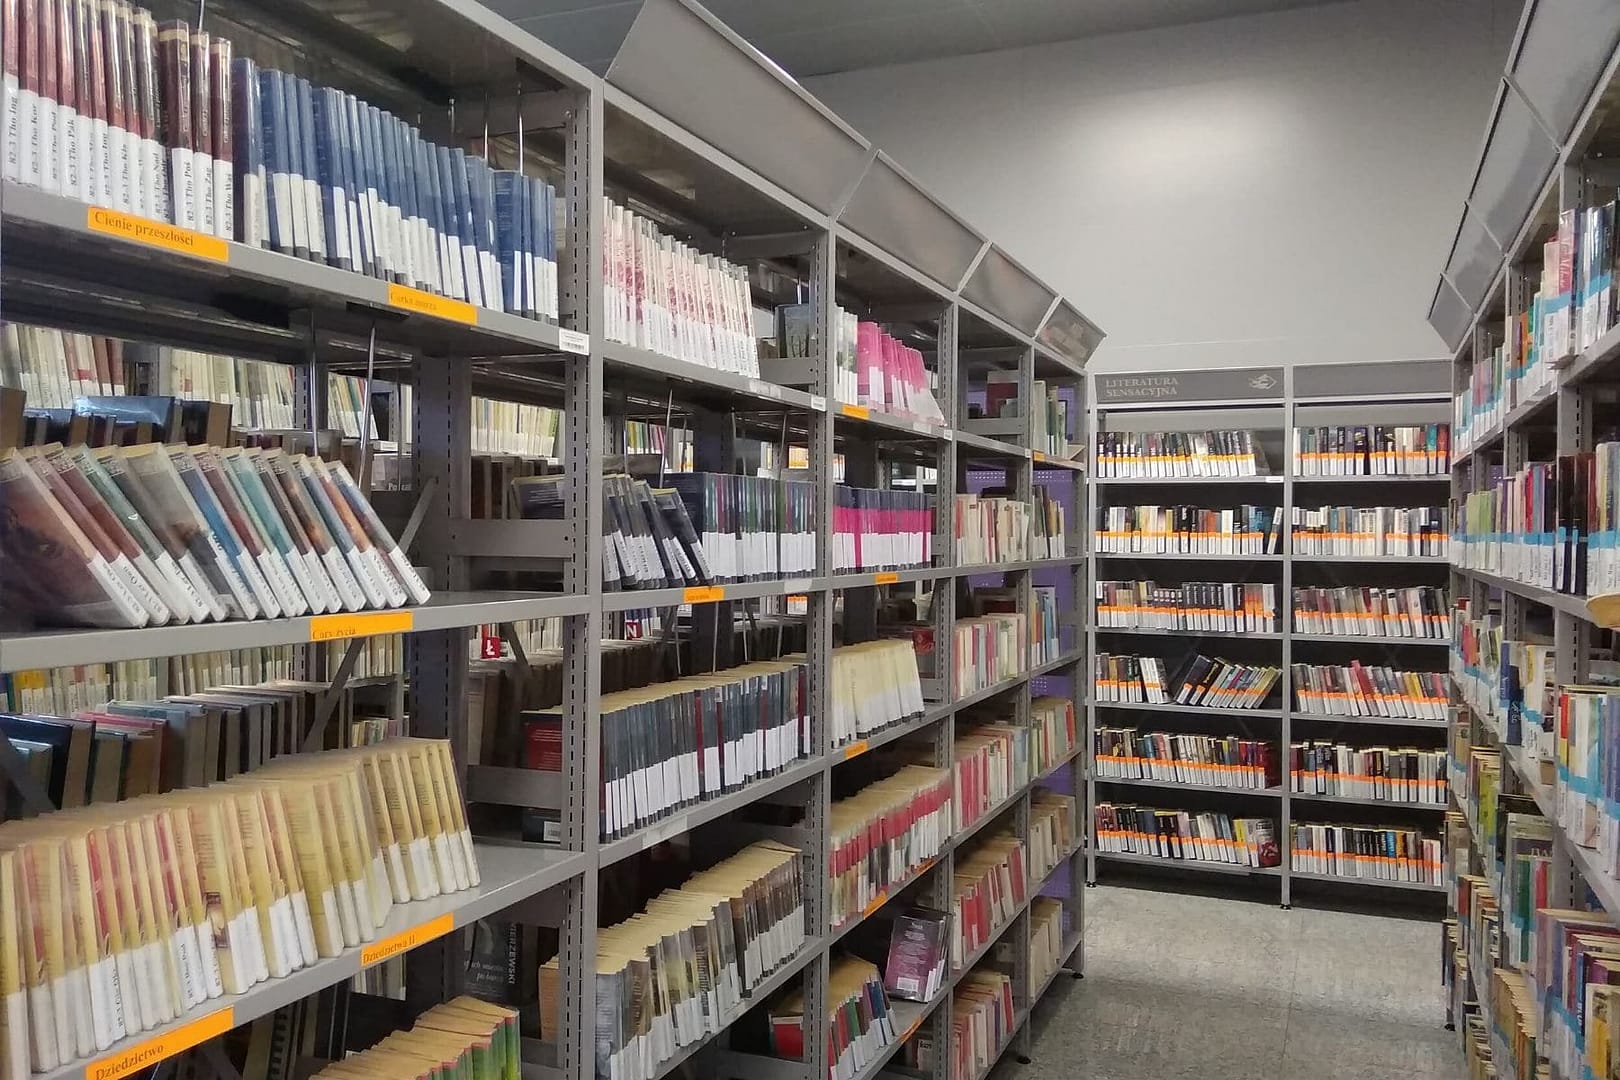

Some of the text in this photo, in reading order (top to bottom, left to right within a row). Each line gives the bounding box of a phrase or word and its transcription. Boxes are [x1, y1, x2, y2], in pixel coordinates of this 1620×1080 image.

[94, 211, 194, 247] Cienie przeszłości
[1105, 377, 1178, 388] LITERATURA
[1105, 387, 1178, 398] SENSACYJNA
[626, 625, 637, 639] N
[486, 643, 496, 656] Ł
[95, 1044, 164, 1080] Dziedzictwo
